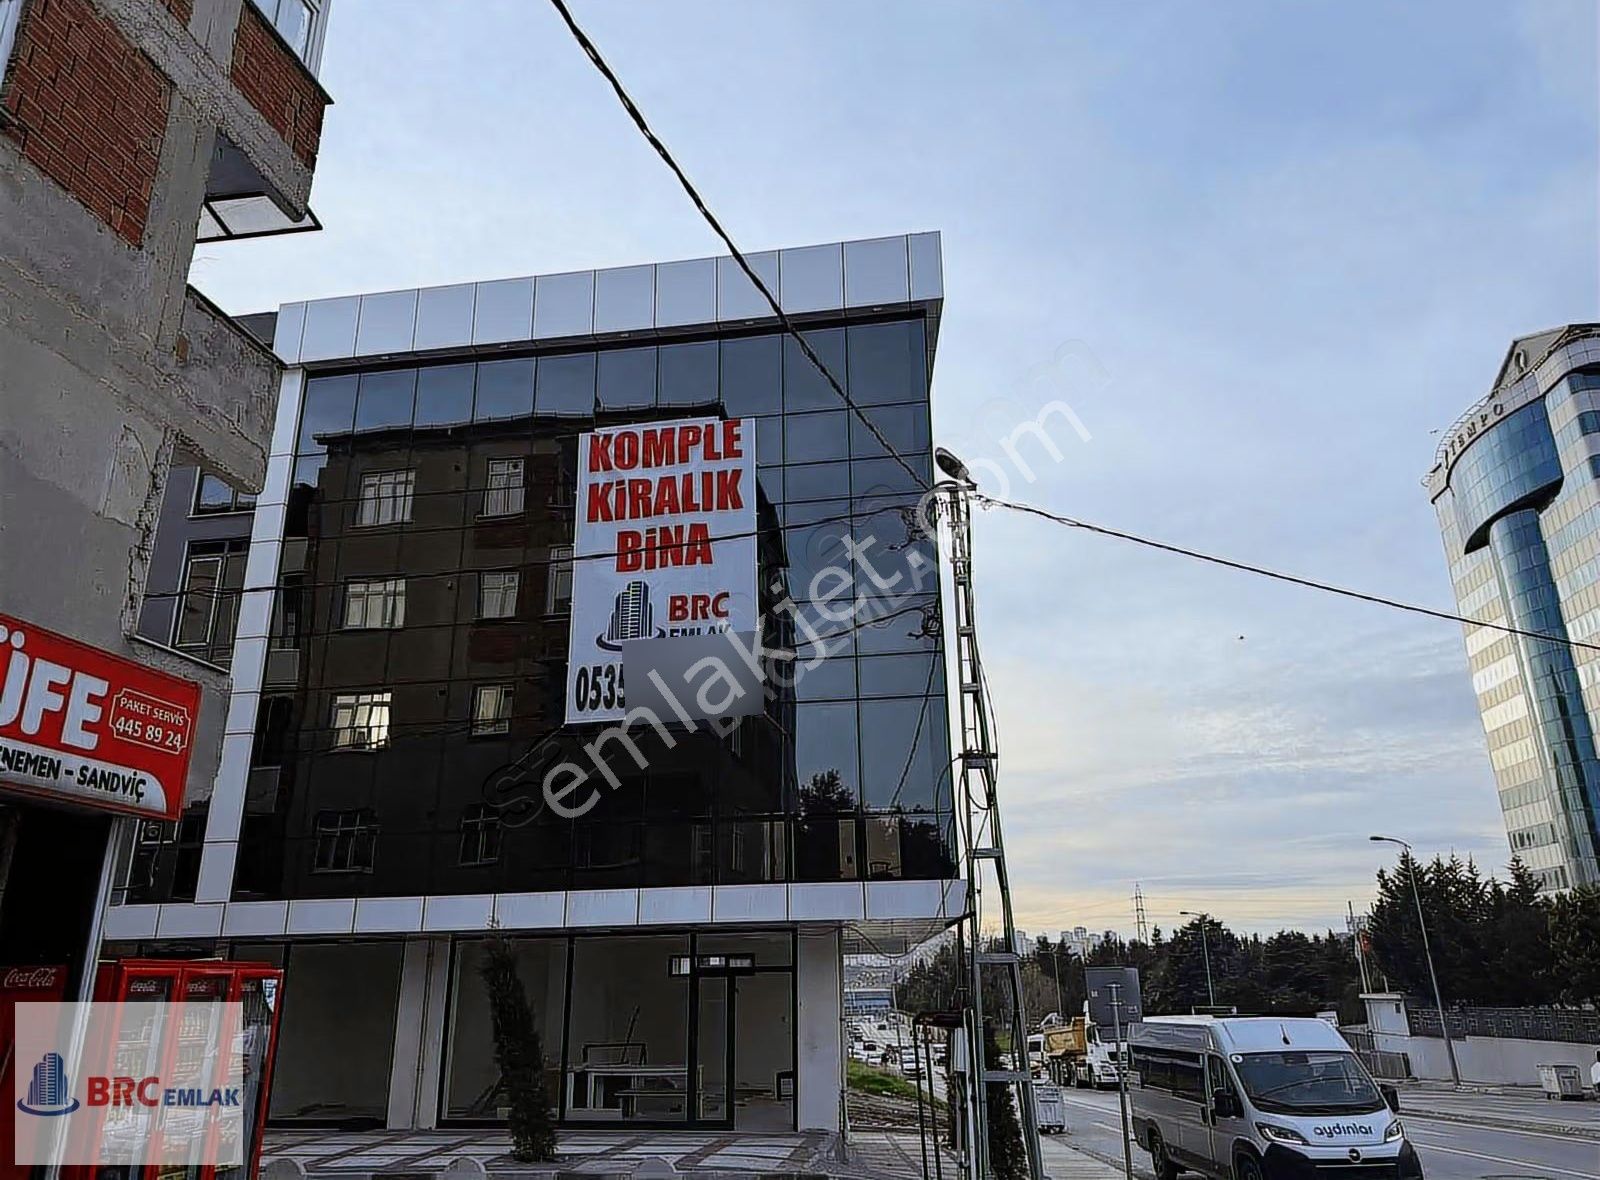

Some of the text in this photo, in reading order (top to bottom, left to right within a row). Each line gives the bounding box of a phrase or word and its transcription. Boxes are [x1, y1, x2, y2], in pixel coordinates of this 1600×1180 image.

[588, 419, 742, 473] KOMPLE
[669, 591, 730, 622] BRC
[120, 697, 152, 716] PAKET
[115, 716, 182, 748] 445 89 24
[0, 746, 62, 780] NEMEN
[76, 771, 147, 803] SANDVİÇ
